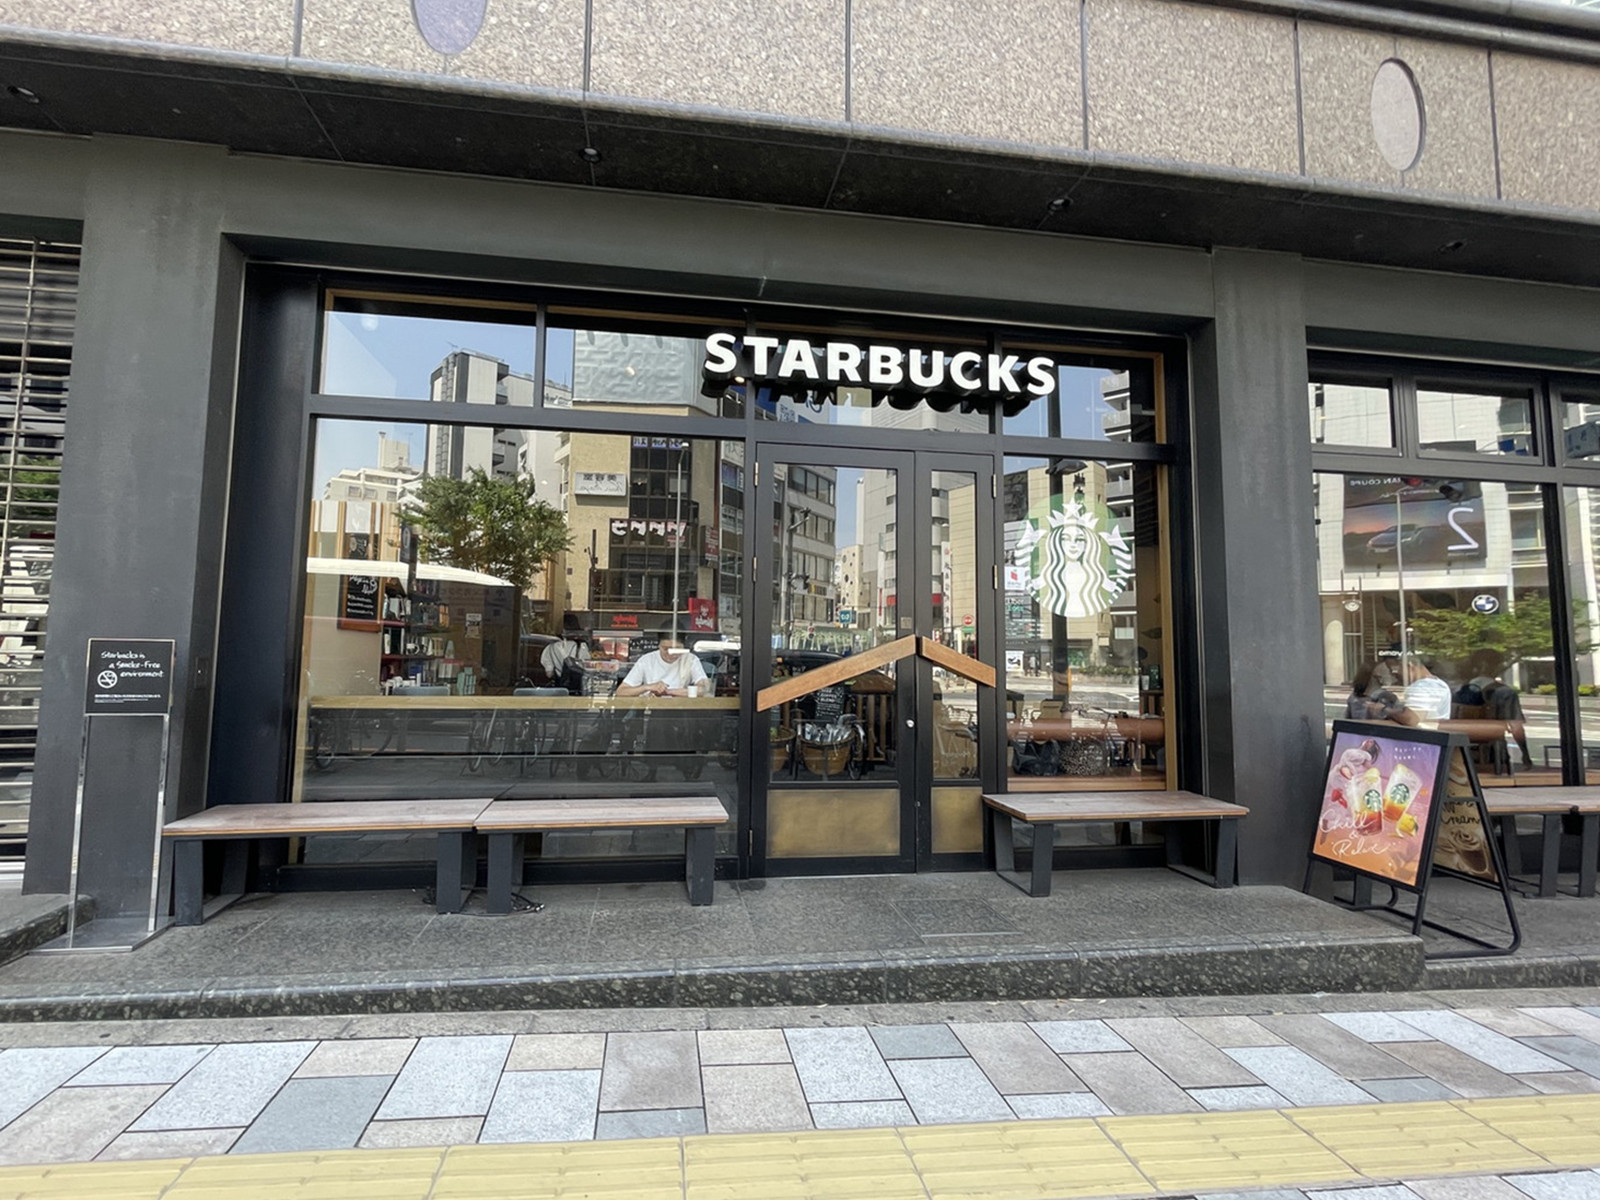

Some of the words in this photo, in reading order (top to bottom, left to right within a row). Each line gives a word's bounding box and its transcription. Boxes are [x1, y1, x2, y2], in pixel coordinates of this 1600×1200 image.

[704, 332, 1056, 397] STARBUCKS
[101, 651, 138, 659] Starbucks
[120, 670, 164, 678] environment
